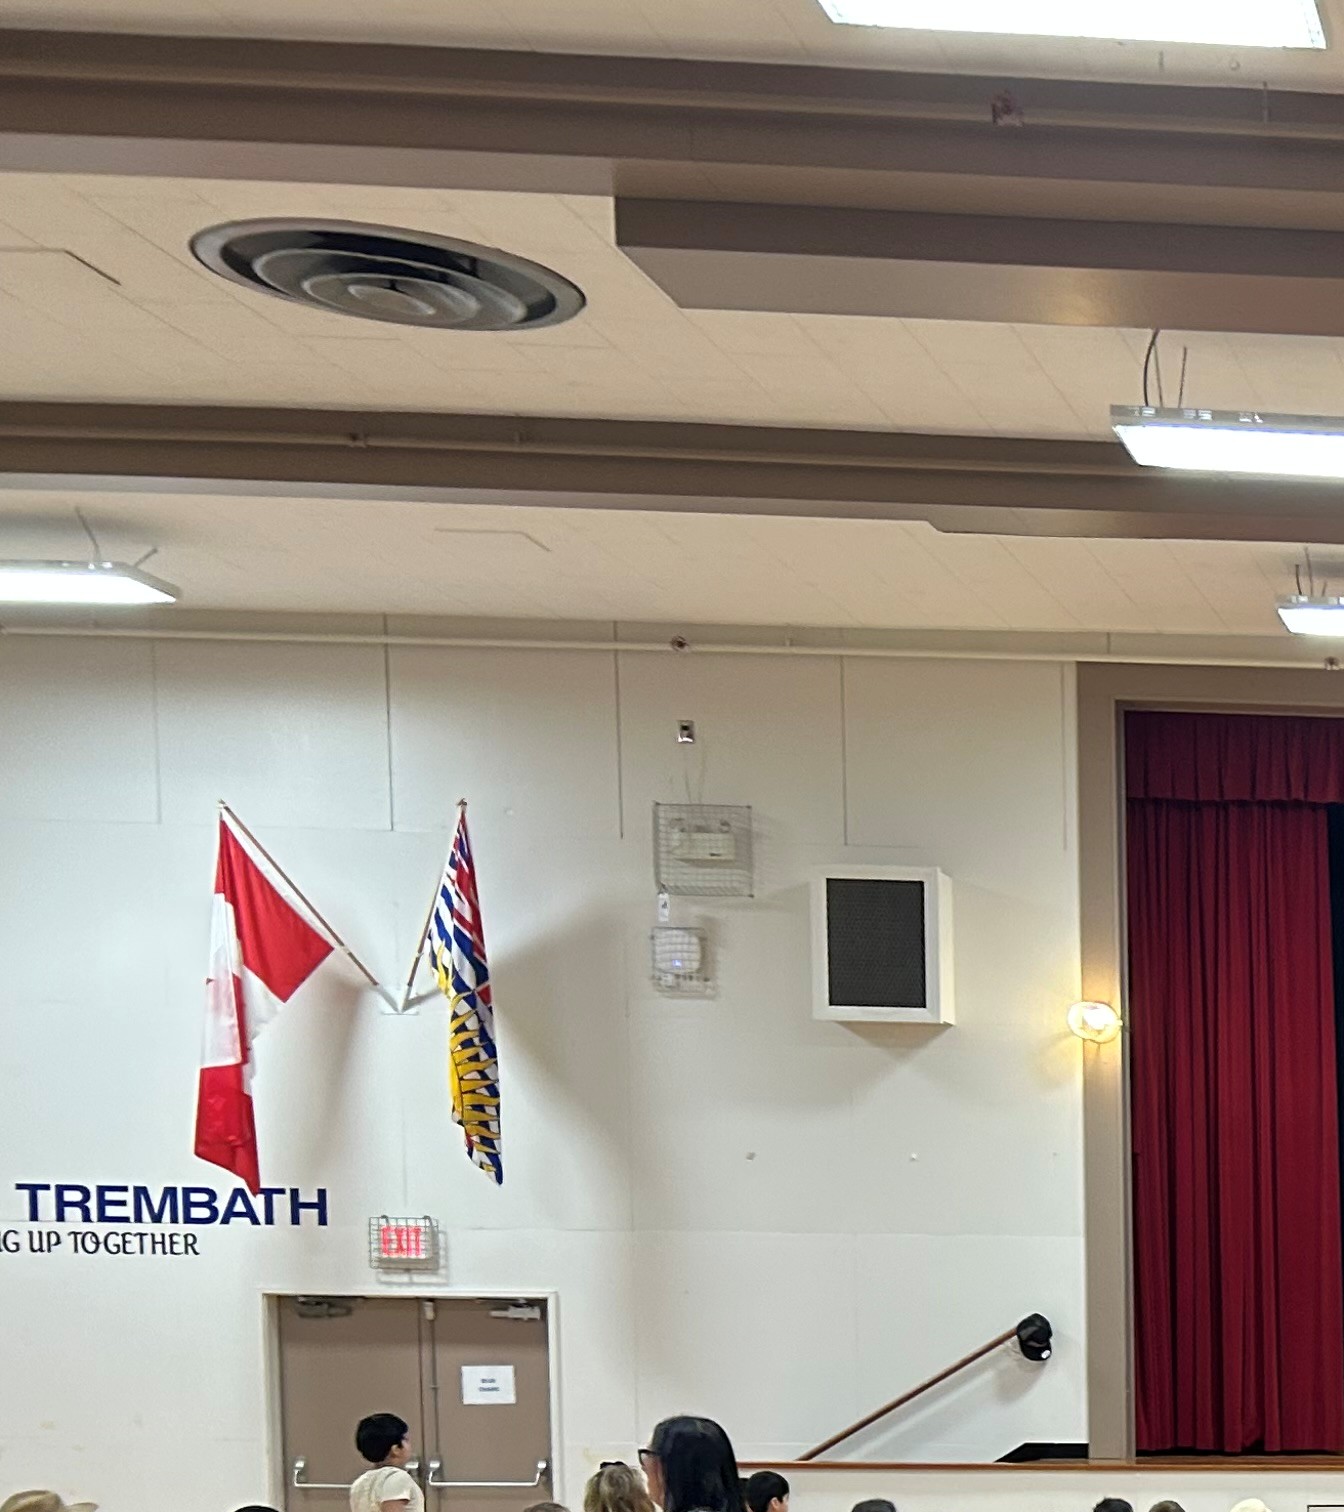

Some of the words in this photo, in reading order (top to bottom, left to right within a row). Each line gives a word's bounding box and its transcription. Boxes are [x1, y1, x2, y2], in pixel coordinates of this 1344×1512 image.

[15, 1183, 328, 1226] TREMBATH
[28, 1230, 61, 1253] UP
[67, 1231, 200, 1256] TOGETHER
[382, 1226, 421, 1256] EXIT
